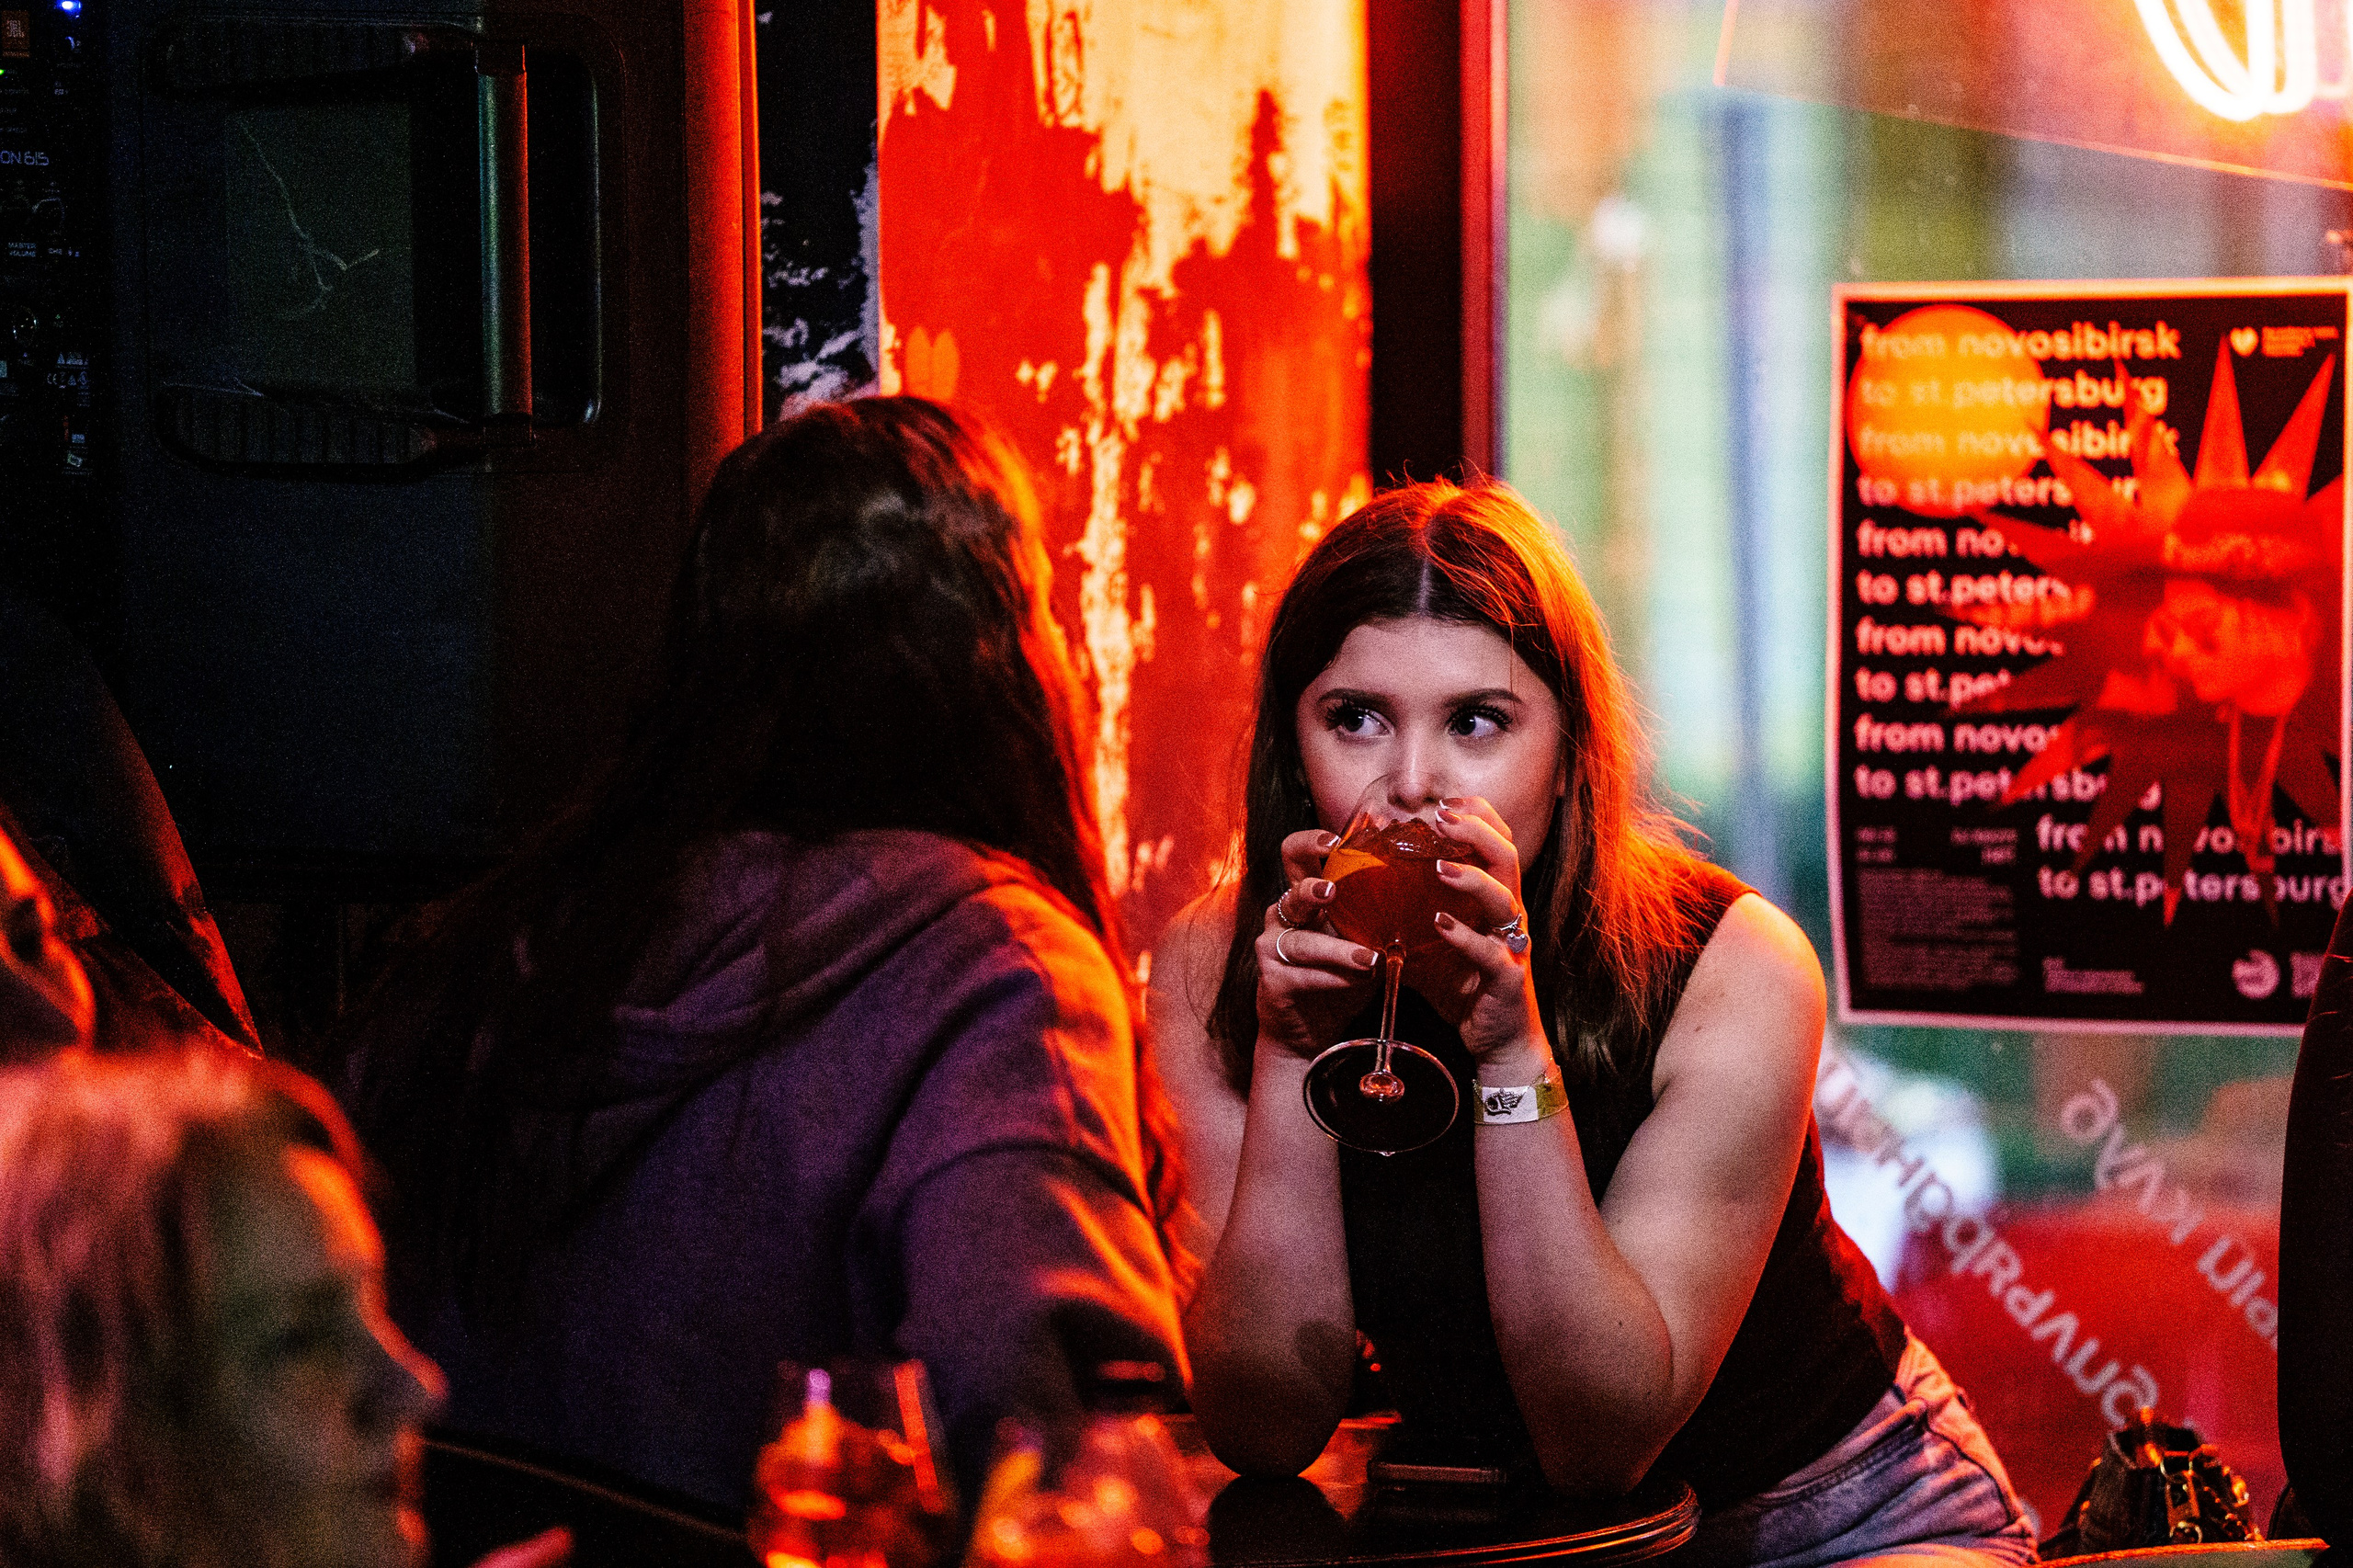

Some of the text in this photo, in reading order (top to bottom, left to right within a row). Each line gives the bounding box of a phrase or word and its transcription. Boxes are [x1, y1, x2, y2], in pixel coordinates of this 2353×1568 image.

[24, 150, 50, 166] 615
[1859, 320, 2182, 360] from novosibirsk
[1859, 378, 1899, 407] to
[1859, 419, 2181, 459] from novosibirk
[1856, 474, 1898, 507] to
[1855, 517, 1948, 558] from
[1855, 568, 1900, 605] to
[1855, 614, 1947, 656] from
[1854, 665, 1898, 703] to
[1853, 711, 1945, 754] from
[1853, 763, 1897, 800] to
[2037, 864, 2345, 910] to st.ptersurg
